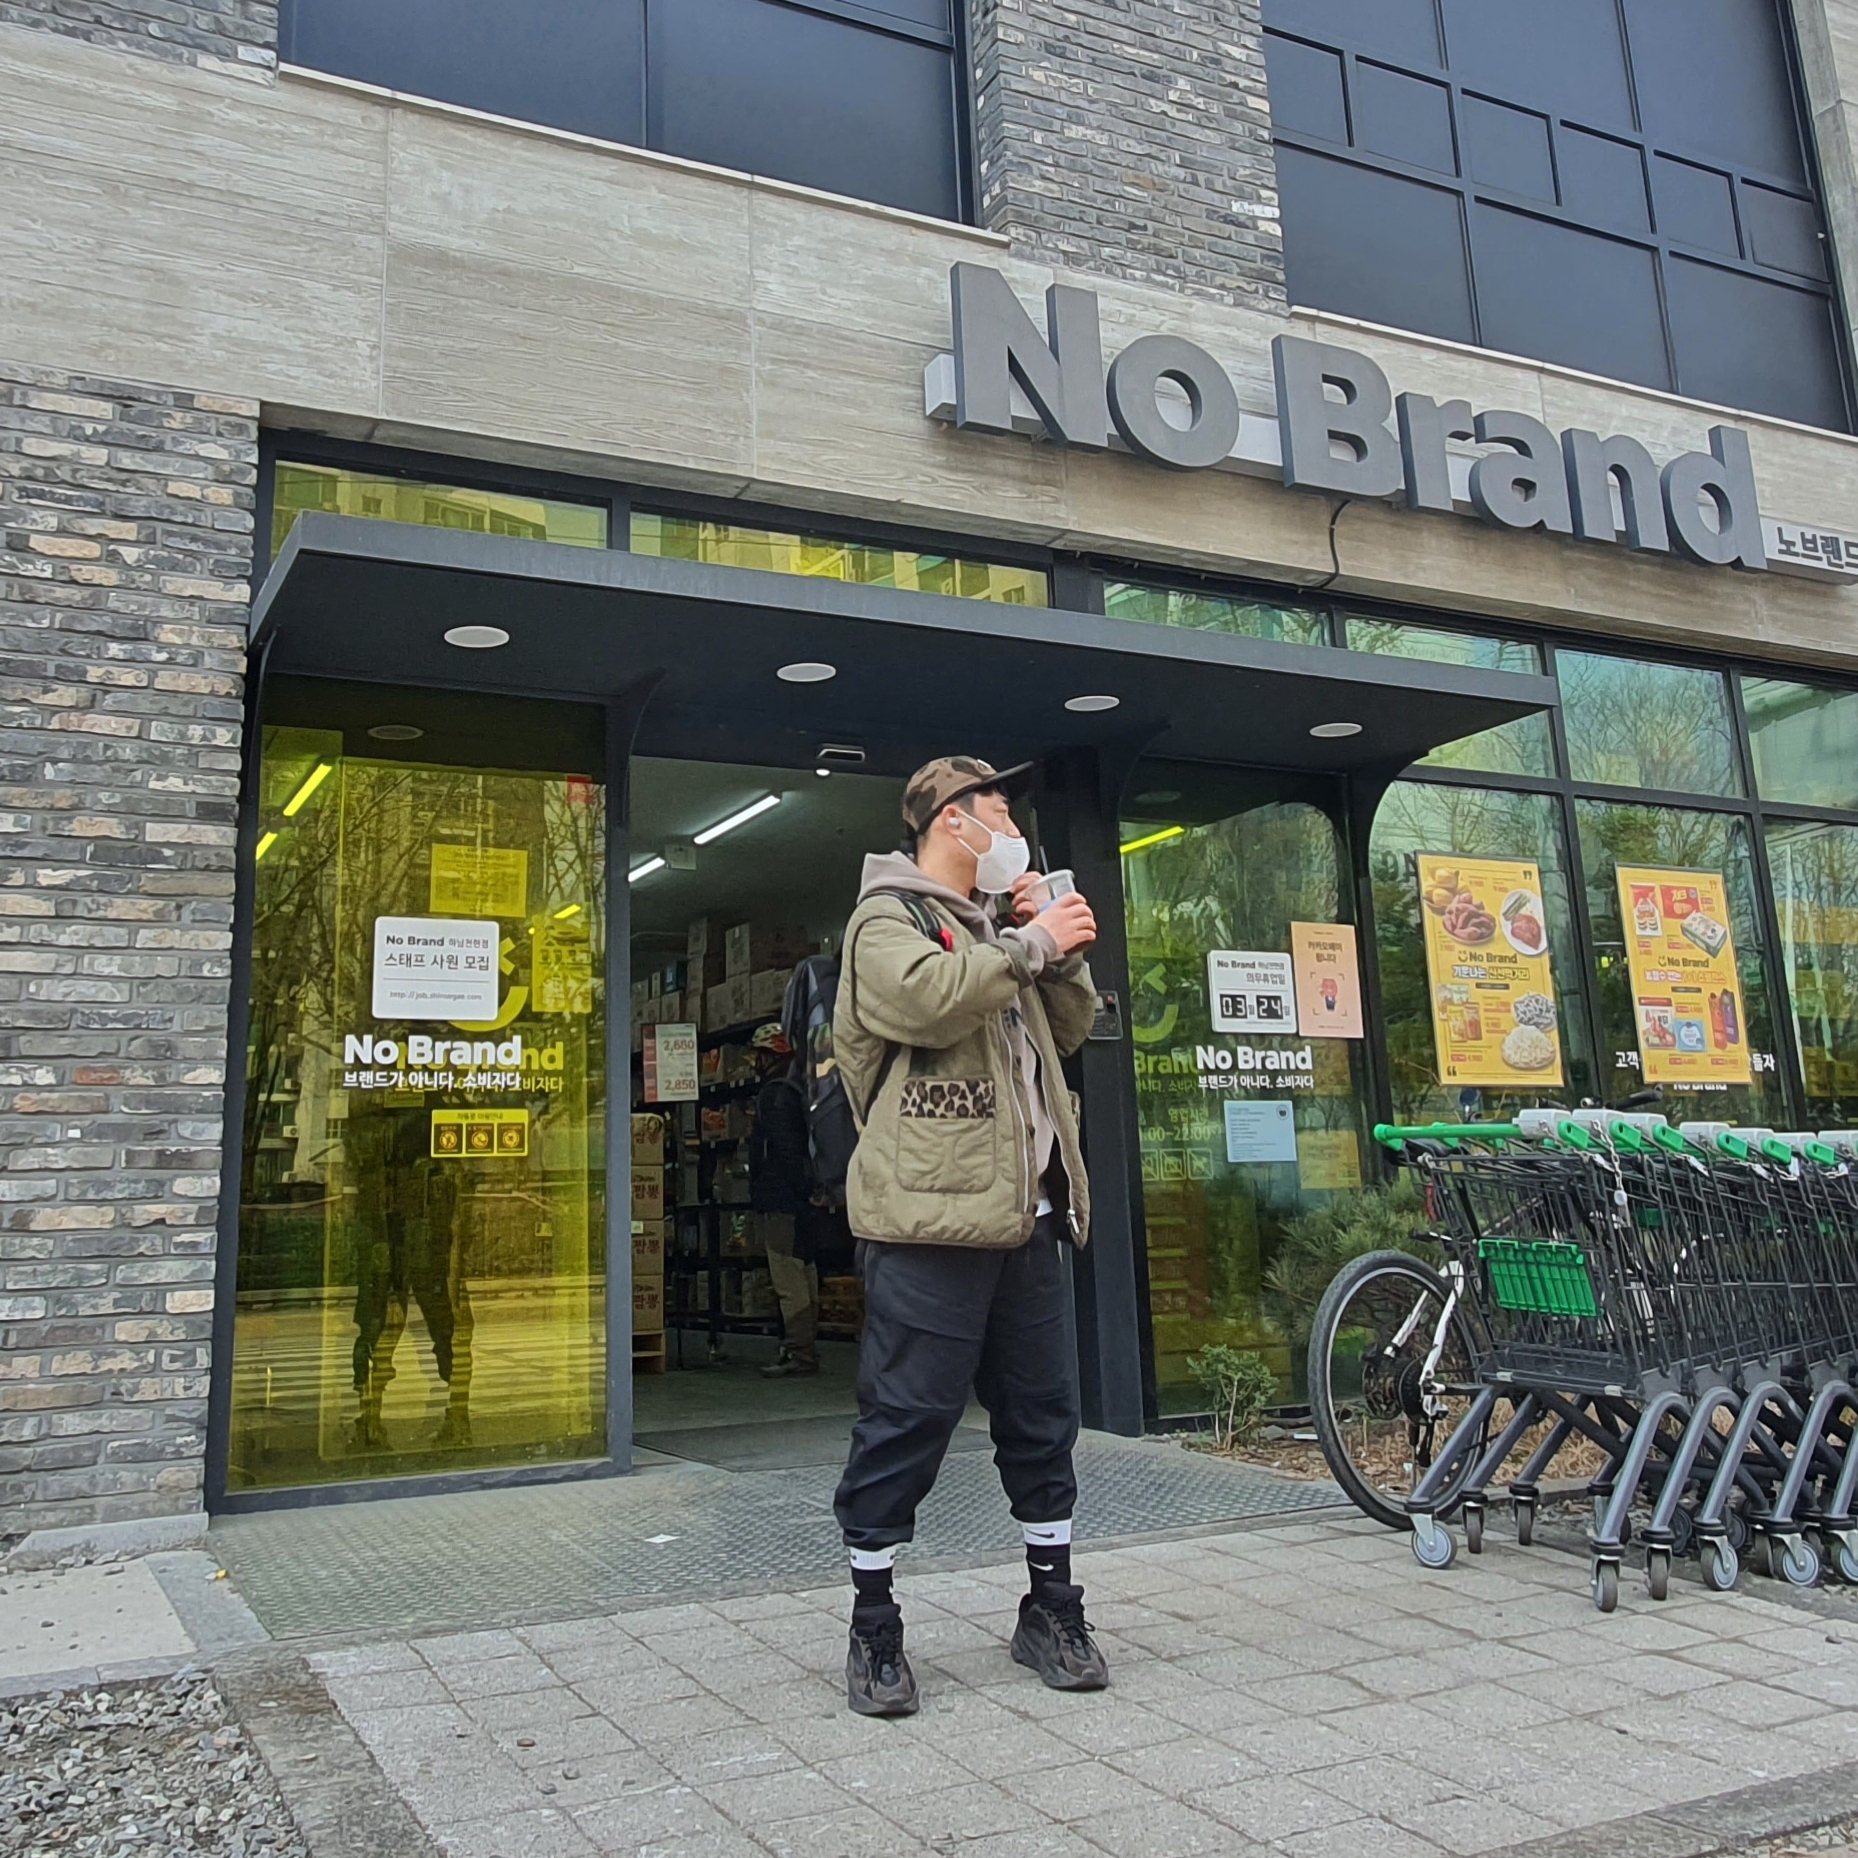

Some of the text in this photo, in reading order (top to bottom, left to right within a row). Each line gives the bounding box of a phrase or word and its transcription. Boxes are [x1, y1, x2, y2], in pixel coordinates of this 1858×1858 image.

[951, 261, 1768, 570] No Brand
[386, 935, 404, 945] No
[407, 936, 445, 947] Brand
[384, 952, 489, 971] 스태프 사원 모집
[1217, 960, 1229, 968] No
[1231, 960, 1256, 969] Brand
[1469, 951, 1518, 964] No Brand
[1667, 956, 1709, 968] No Brand
[344, 1034, 400, 1065] No
[407, 1034, 522, 1065] Brand
[1195, 1045, 1313, 1070] No Brand
[343, 1070, 405, 1088] 브랜드가
[408, 1070, 458, 1090] 아니다.
[463, 1070, 523, 1090] 소비자다
[1198, 1075, 1314, 1090] 브랜드가 아니다. 소비자다
